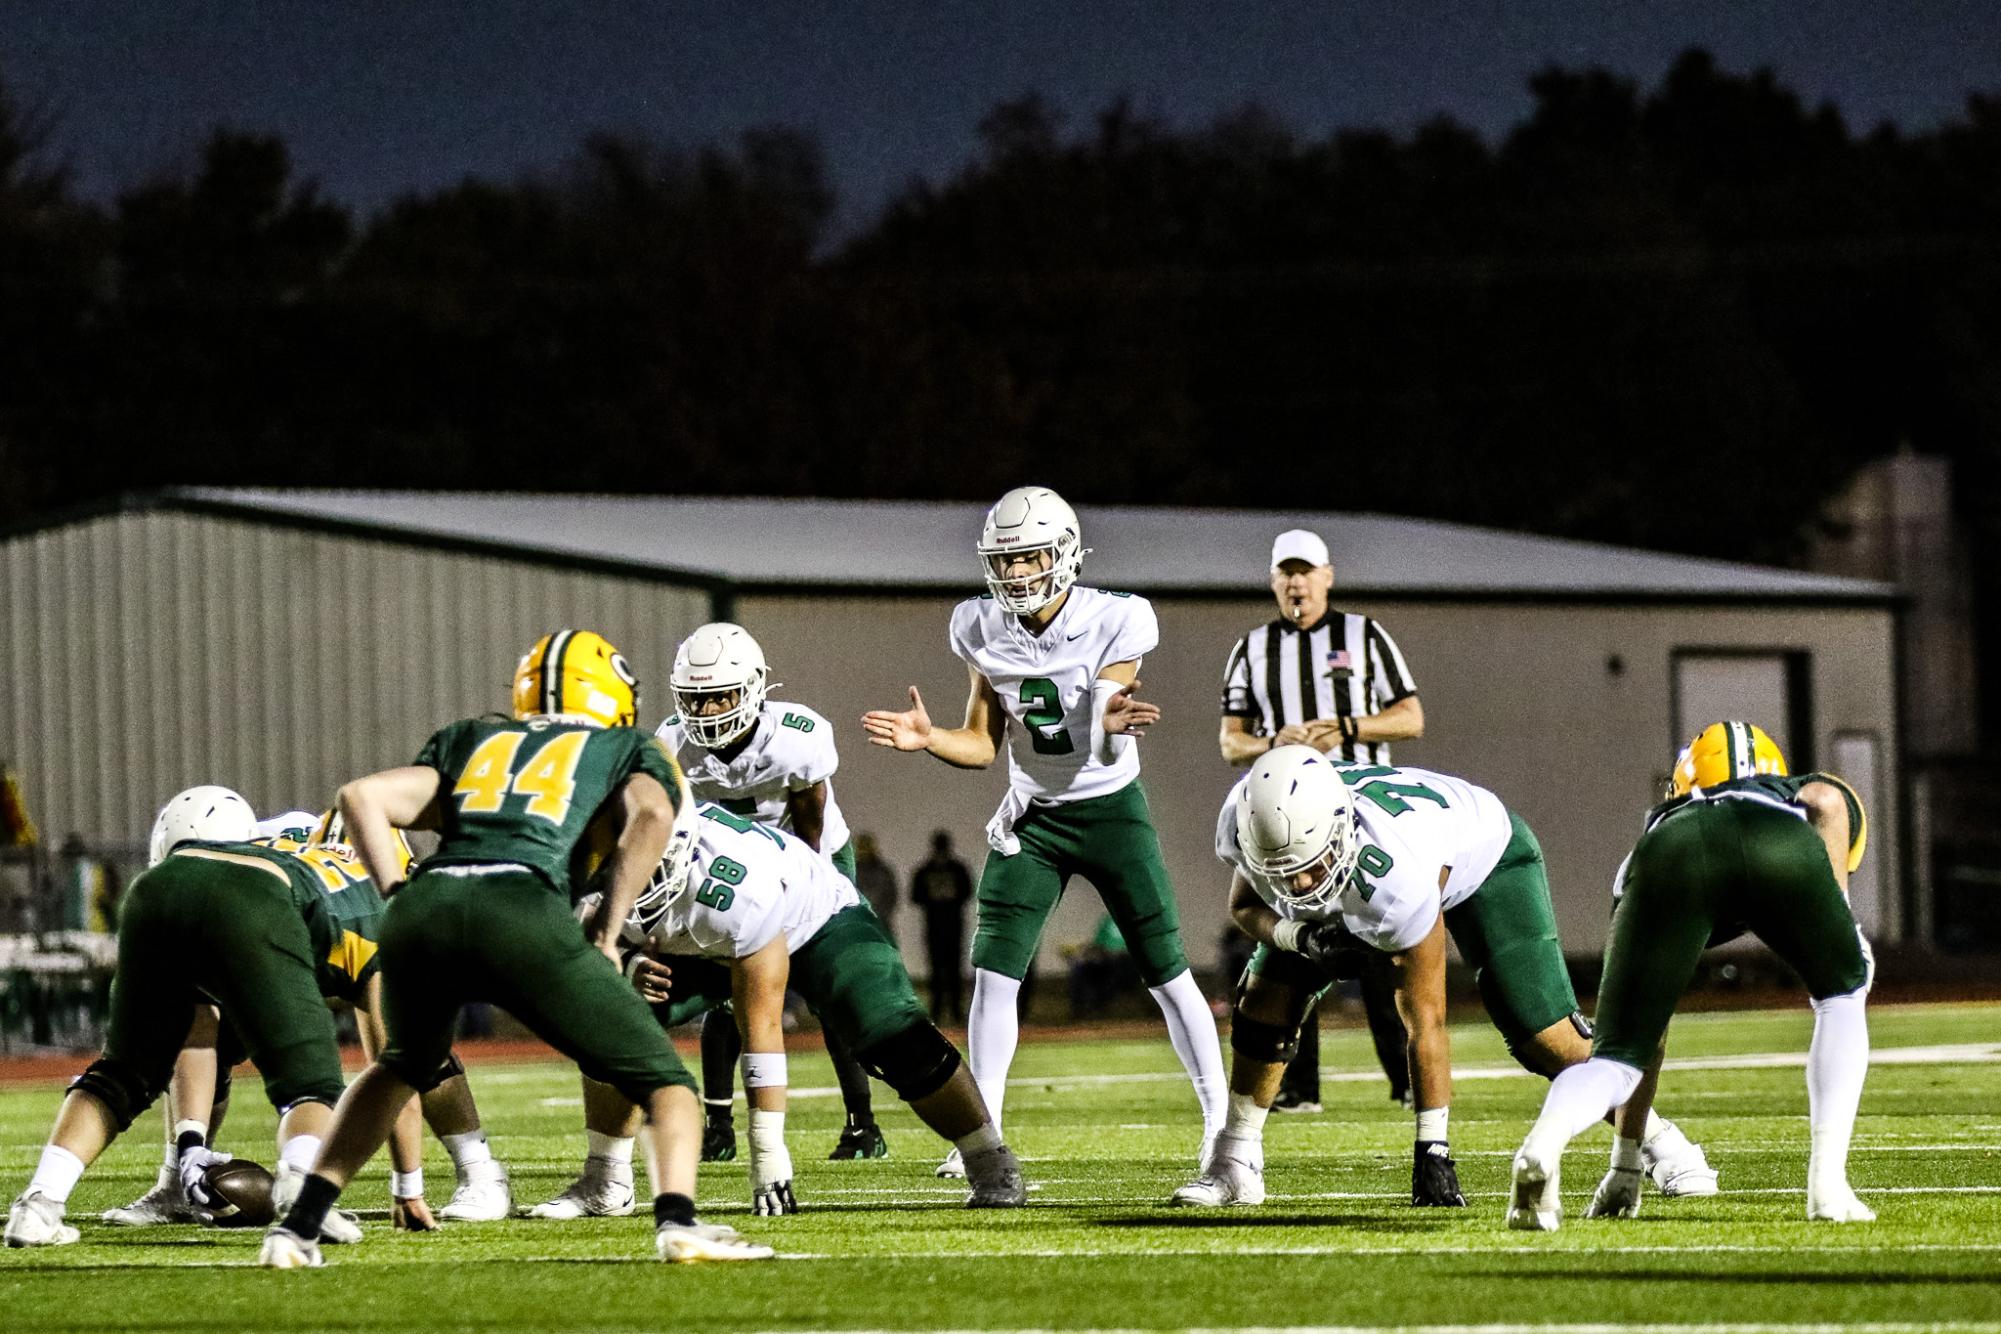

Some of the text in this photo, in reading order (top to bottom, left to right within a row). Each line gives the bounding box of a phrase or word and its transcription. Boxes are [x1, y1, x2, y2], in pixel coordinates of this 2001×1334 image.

[782, 711, 816, 734] 5
[1019, 677, 1075, 755] 2
[452, 730, 592, 827] 44
[695, 854, 748, 913] 58
[1350, 844, 1394, 902] 70
